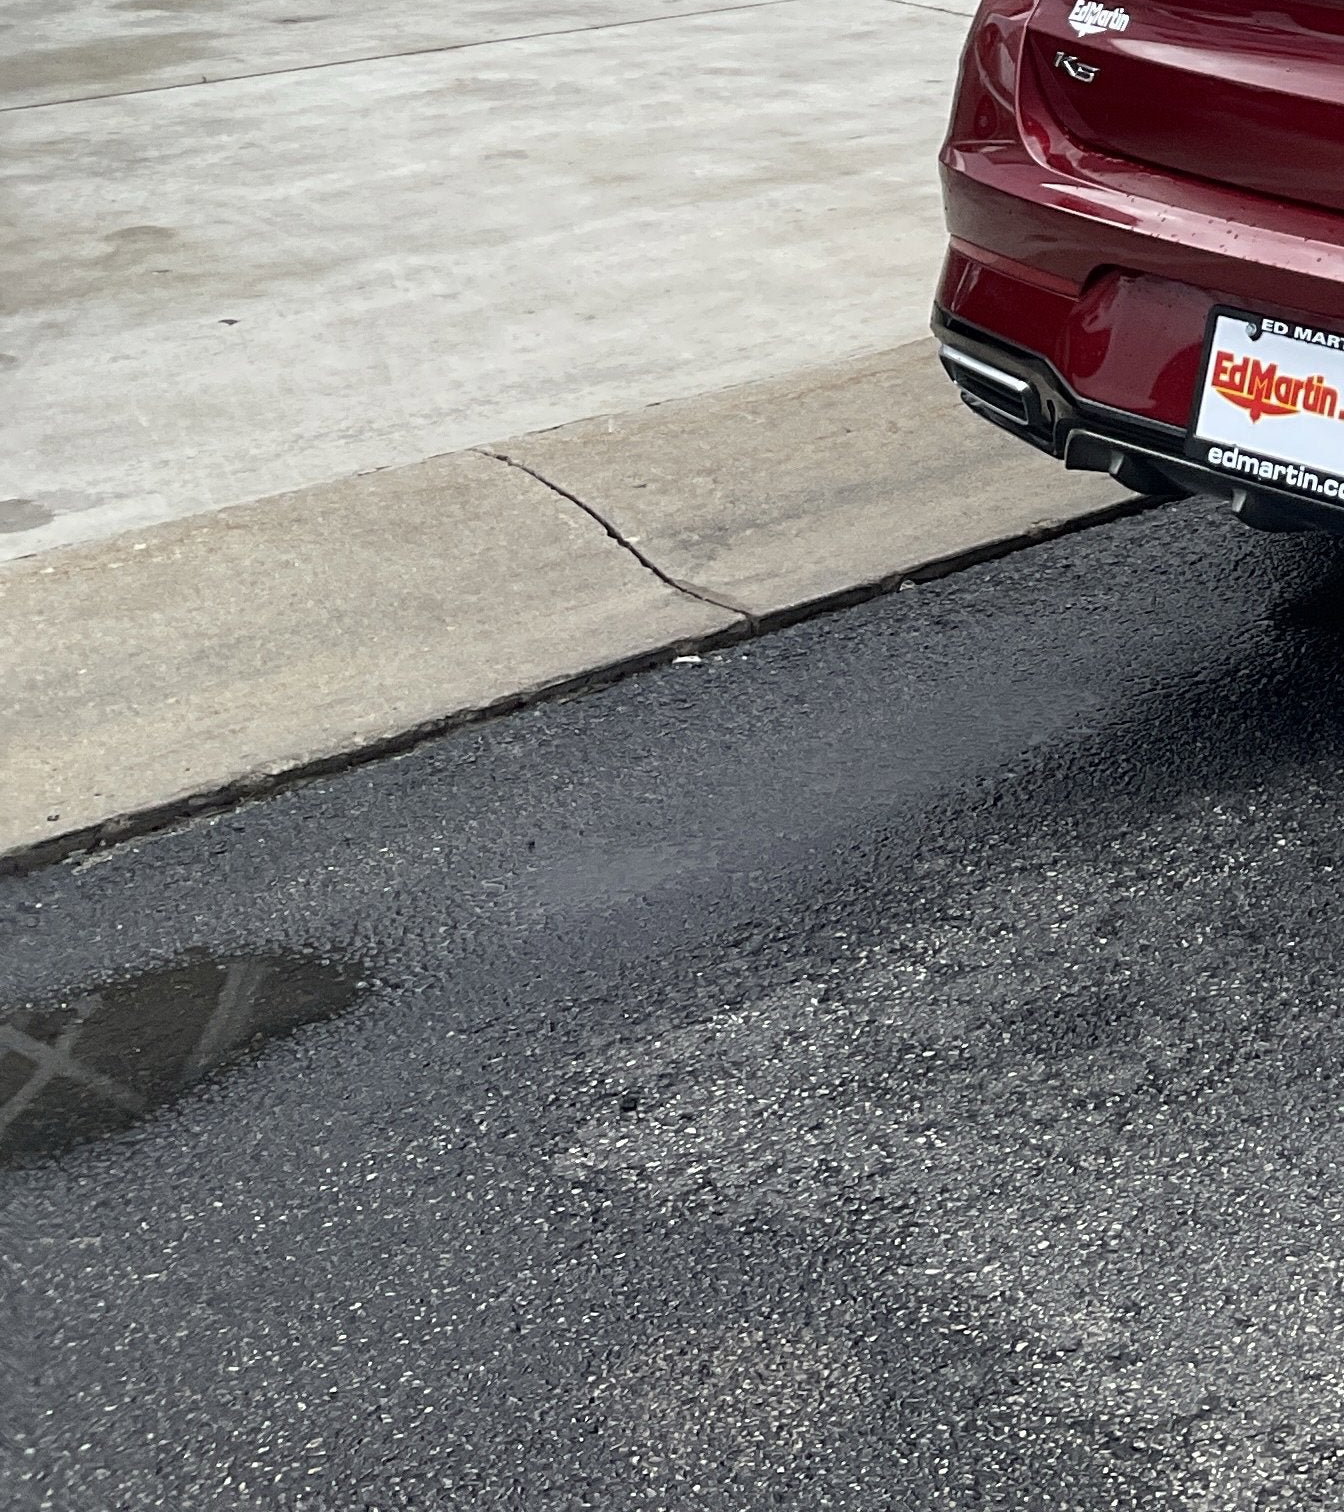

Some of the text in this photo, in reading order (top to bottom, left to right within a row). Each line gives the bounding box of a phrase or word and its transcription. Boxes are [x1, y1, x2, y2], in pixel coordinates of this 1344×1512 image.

[1068, 0, 1130, 32] EdMartin
[1054, 51, 1101, 83] K5
[1261, 318, 1289, 336] ED
